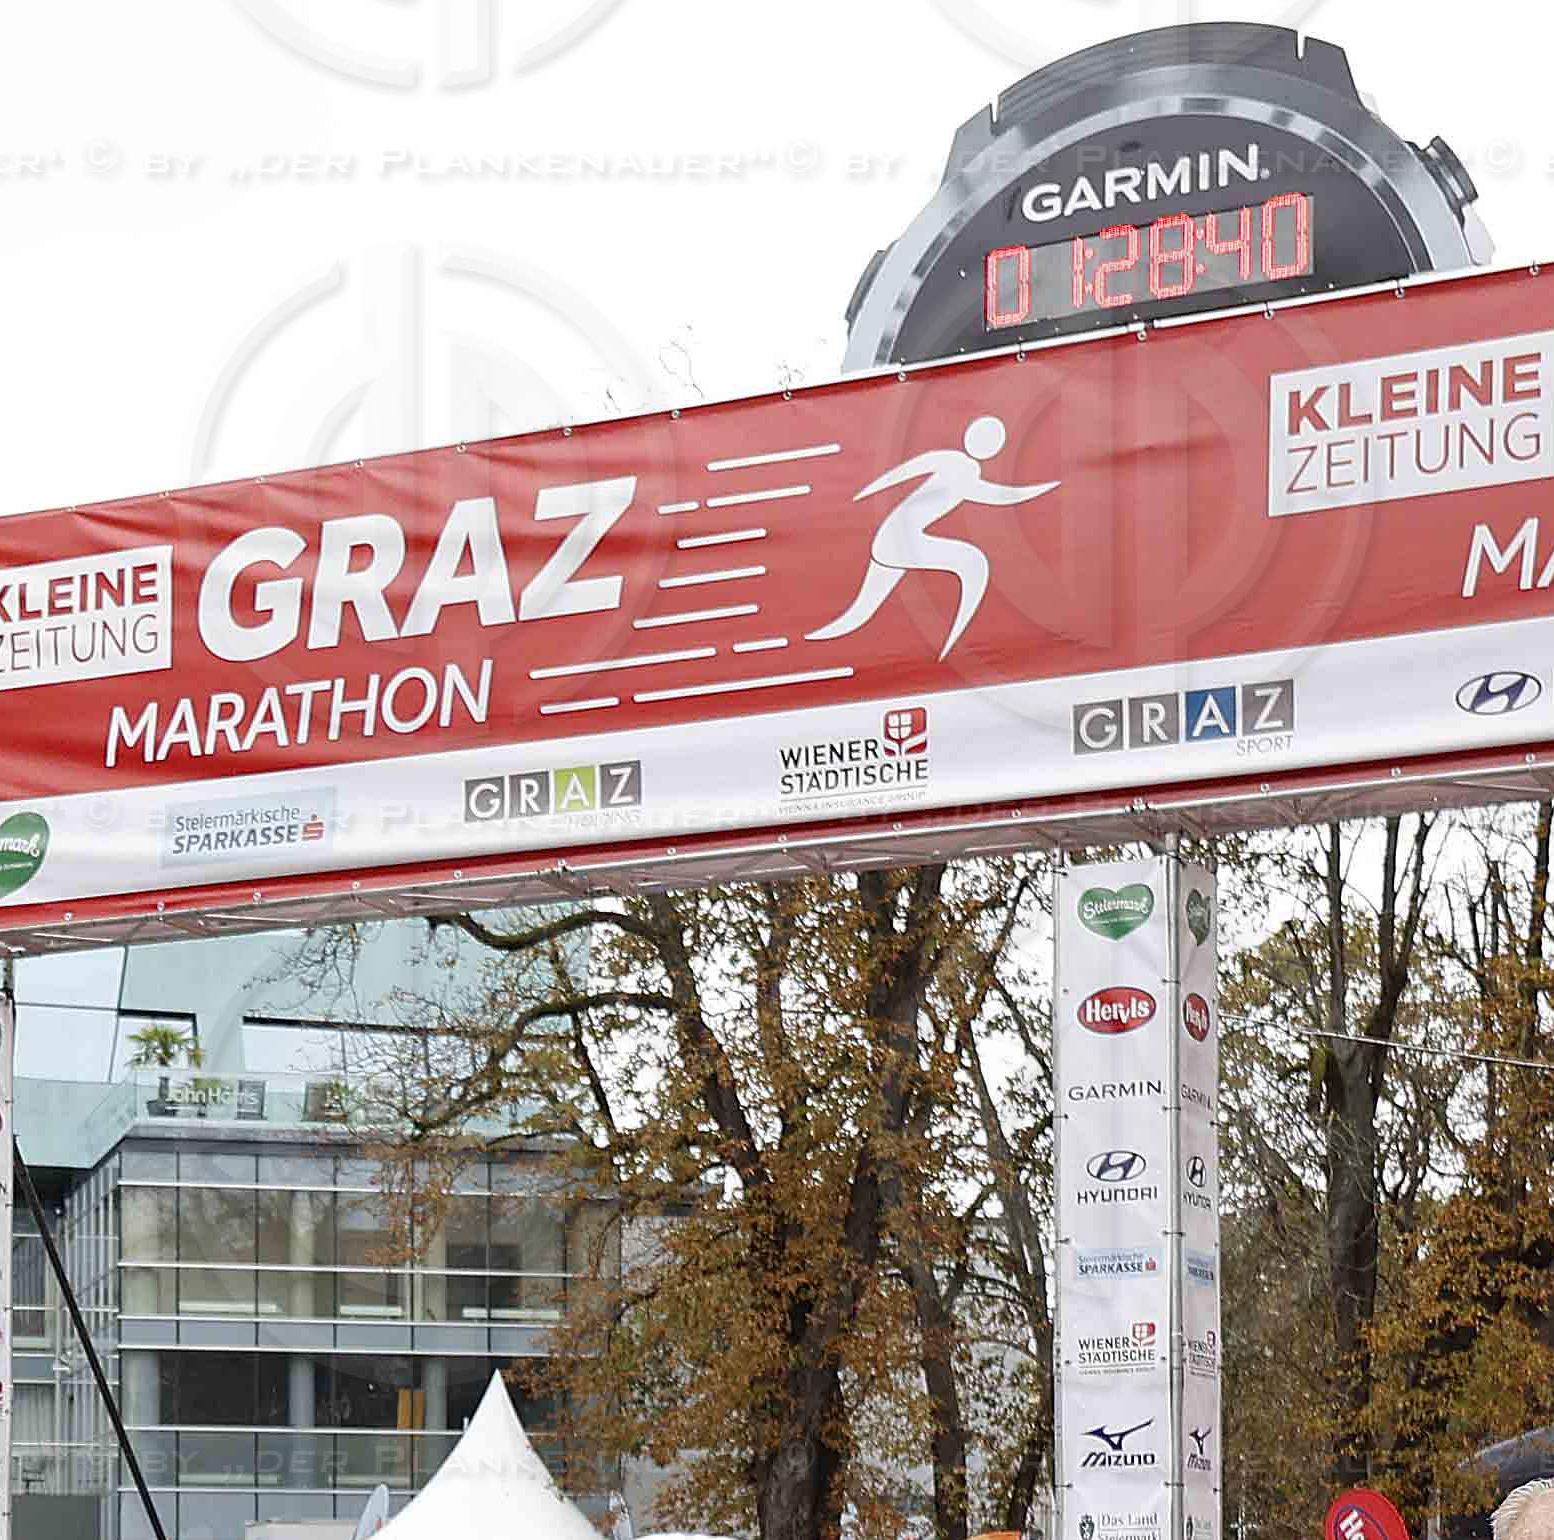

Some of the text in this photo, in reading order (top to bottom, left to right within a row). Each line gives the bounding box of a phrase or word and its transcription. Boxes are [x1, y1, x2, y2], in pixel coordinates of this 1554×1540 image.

[1022, 143, 1265, 223] GARMIN
[1286, 352, 1542, 436] KLEINE
[1286, 411, 1541, 494] ZEITUNG
[197, 476, 638, 662] GRAZ
[105, 660, 493, 768] MARATHON
[1074, 680, 1294, 753] GRAZ
[780, 739, 879, 770] WIENER
[1236, 734, 1294, 756] SPORT
[780, 759, 929, 795] STÄDTISCHE
[466, 764, 638, 821] GRAZ
[176, 807, 300, 833] Steiermärkische
[172, 828, 298, 855] SPARKASSE
[1085, 994, 1150, 1024] Hervis
[1068, 1079, 1165, 1101] GARMIN
[1077, 1186, 1158, 1204] HYUNDAI
[1078, 1262, 1143, 1276] SPARKASSE
[1078, 1336, 1129, 1351] WIENER
[1100, 1512, 1158, 1527] Das Land
